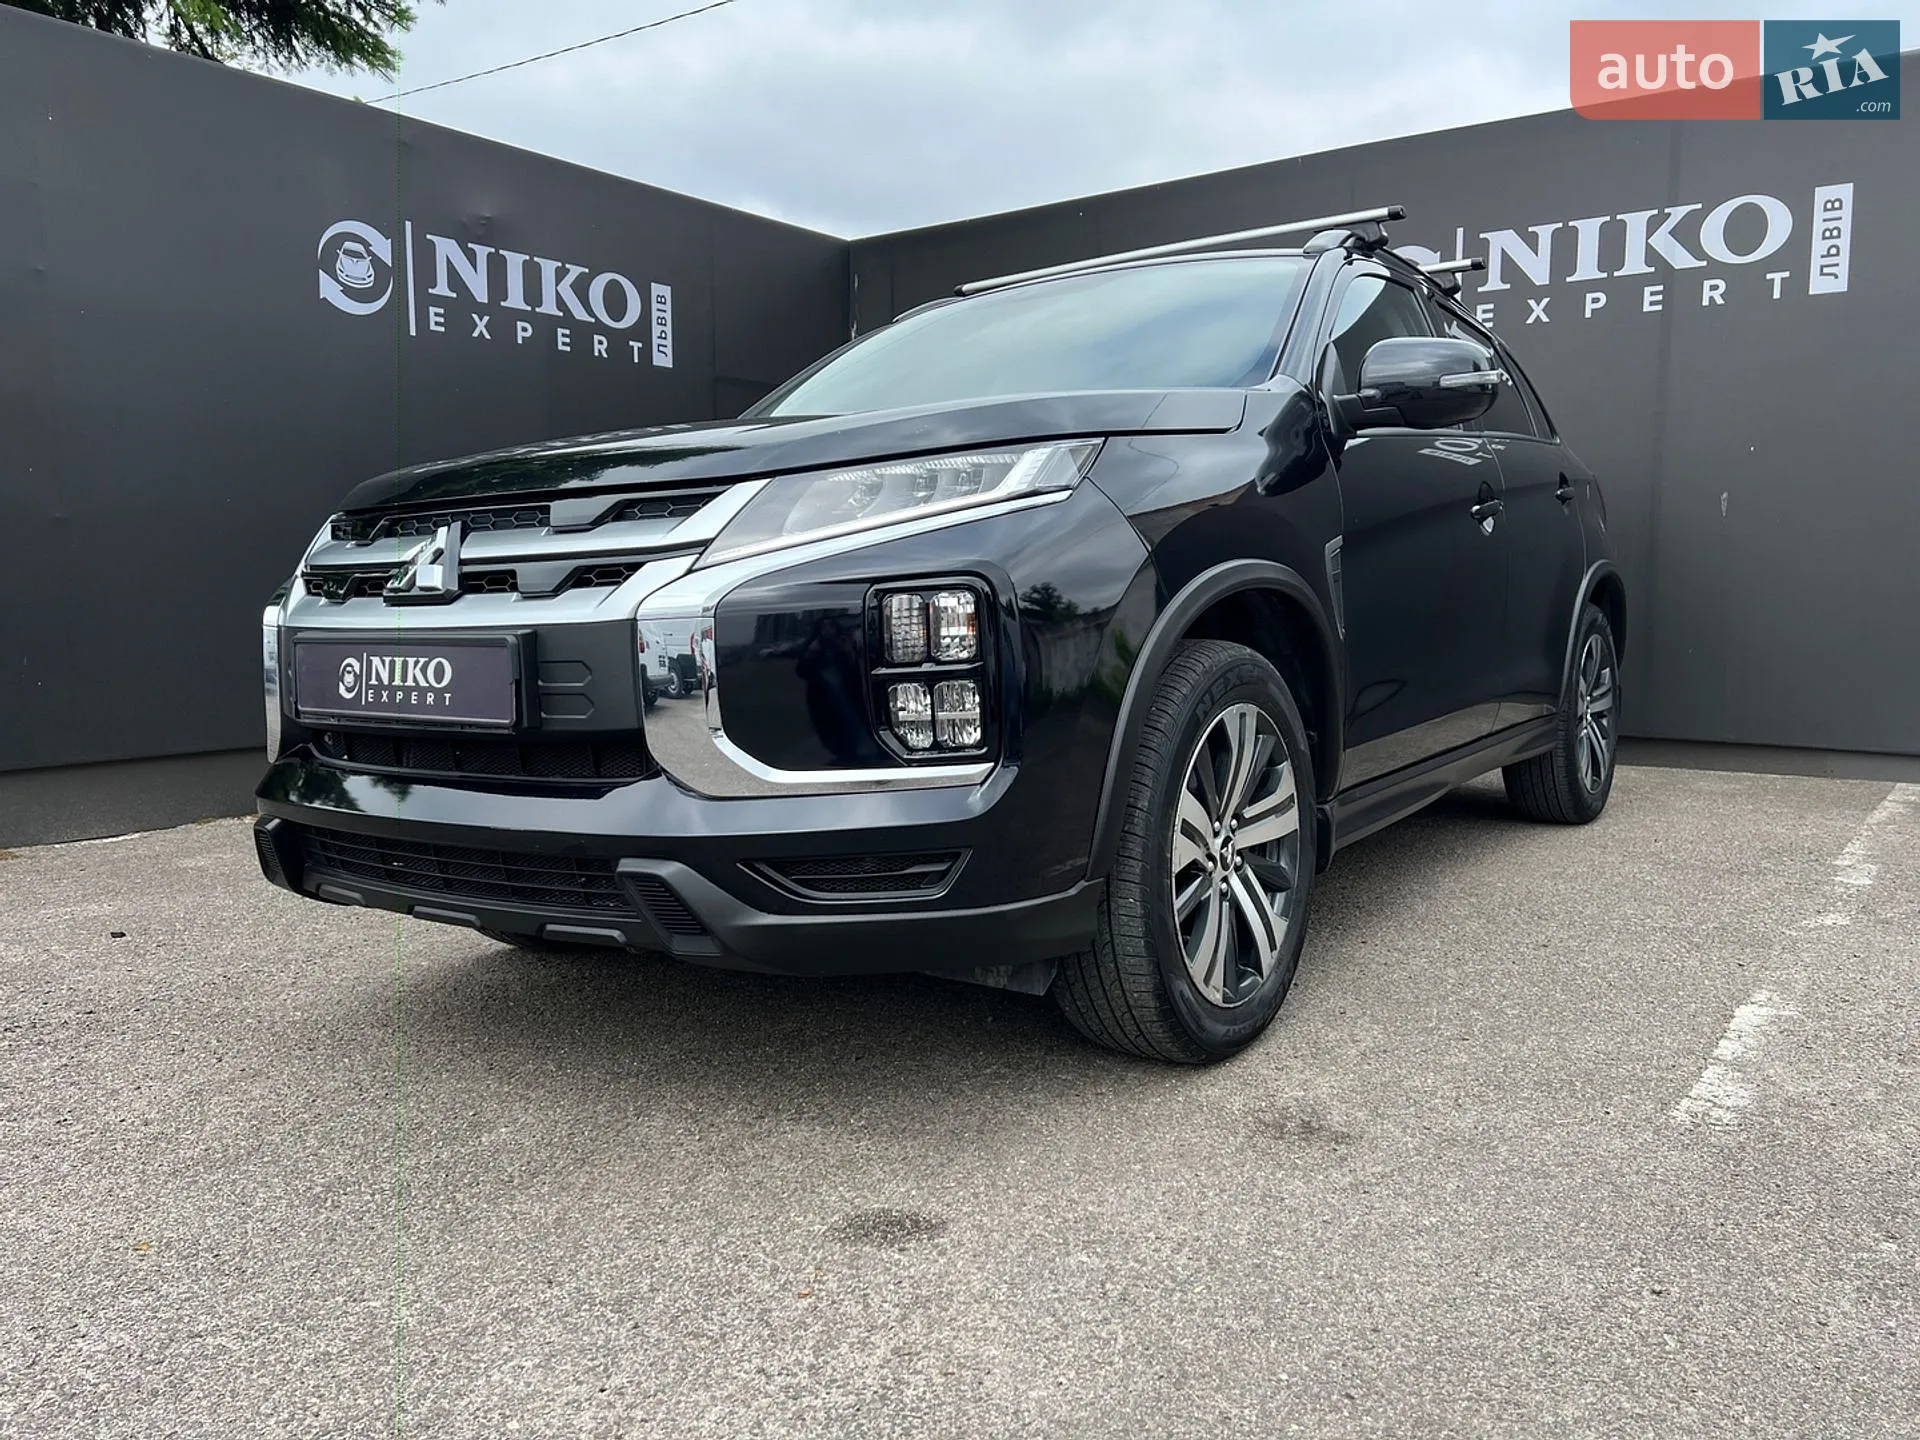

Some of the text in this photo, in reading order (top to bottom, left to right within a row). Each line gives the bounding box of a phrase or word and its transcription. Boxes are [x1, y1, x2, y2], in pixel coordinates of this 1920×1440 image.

[1477, 194, 1794, 293] NIKO
[425, 233, 642, 329] NIKO
[1475, 270, 1791, 329] EXPERT
[428, 305, 643, 364] EXPERT
[367, 689, 452, 706] EXPERT
[368, 655, 453, 689] NIKO
